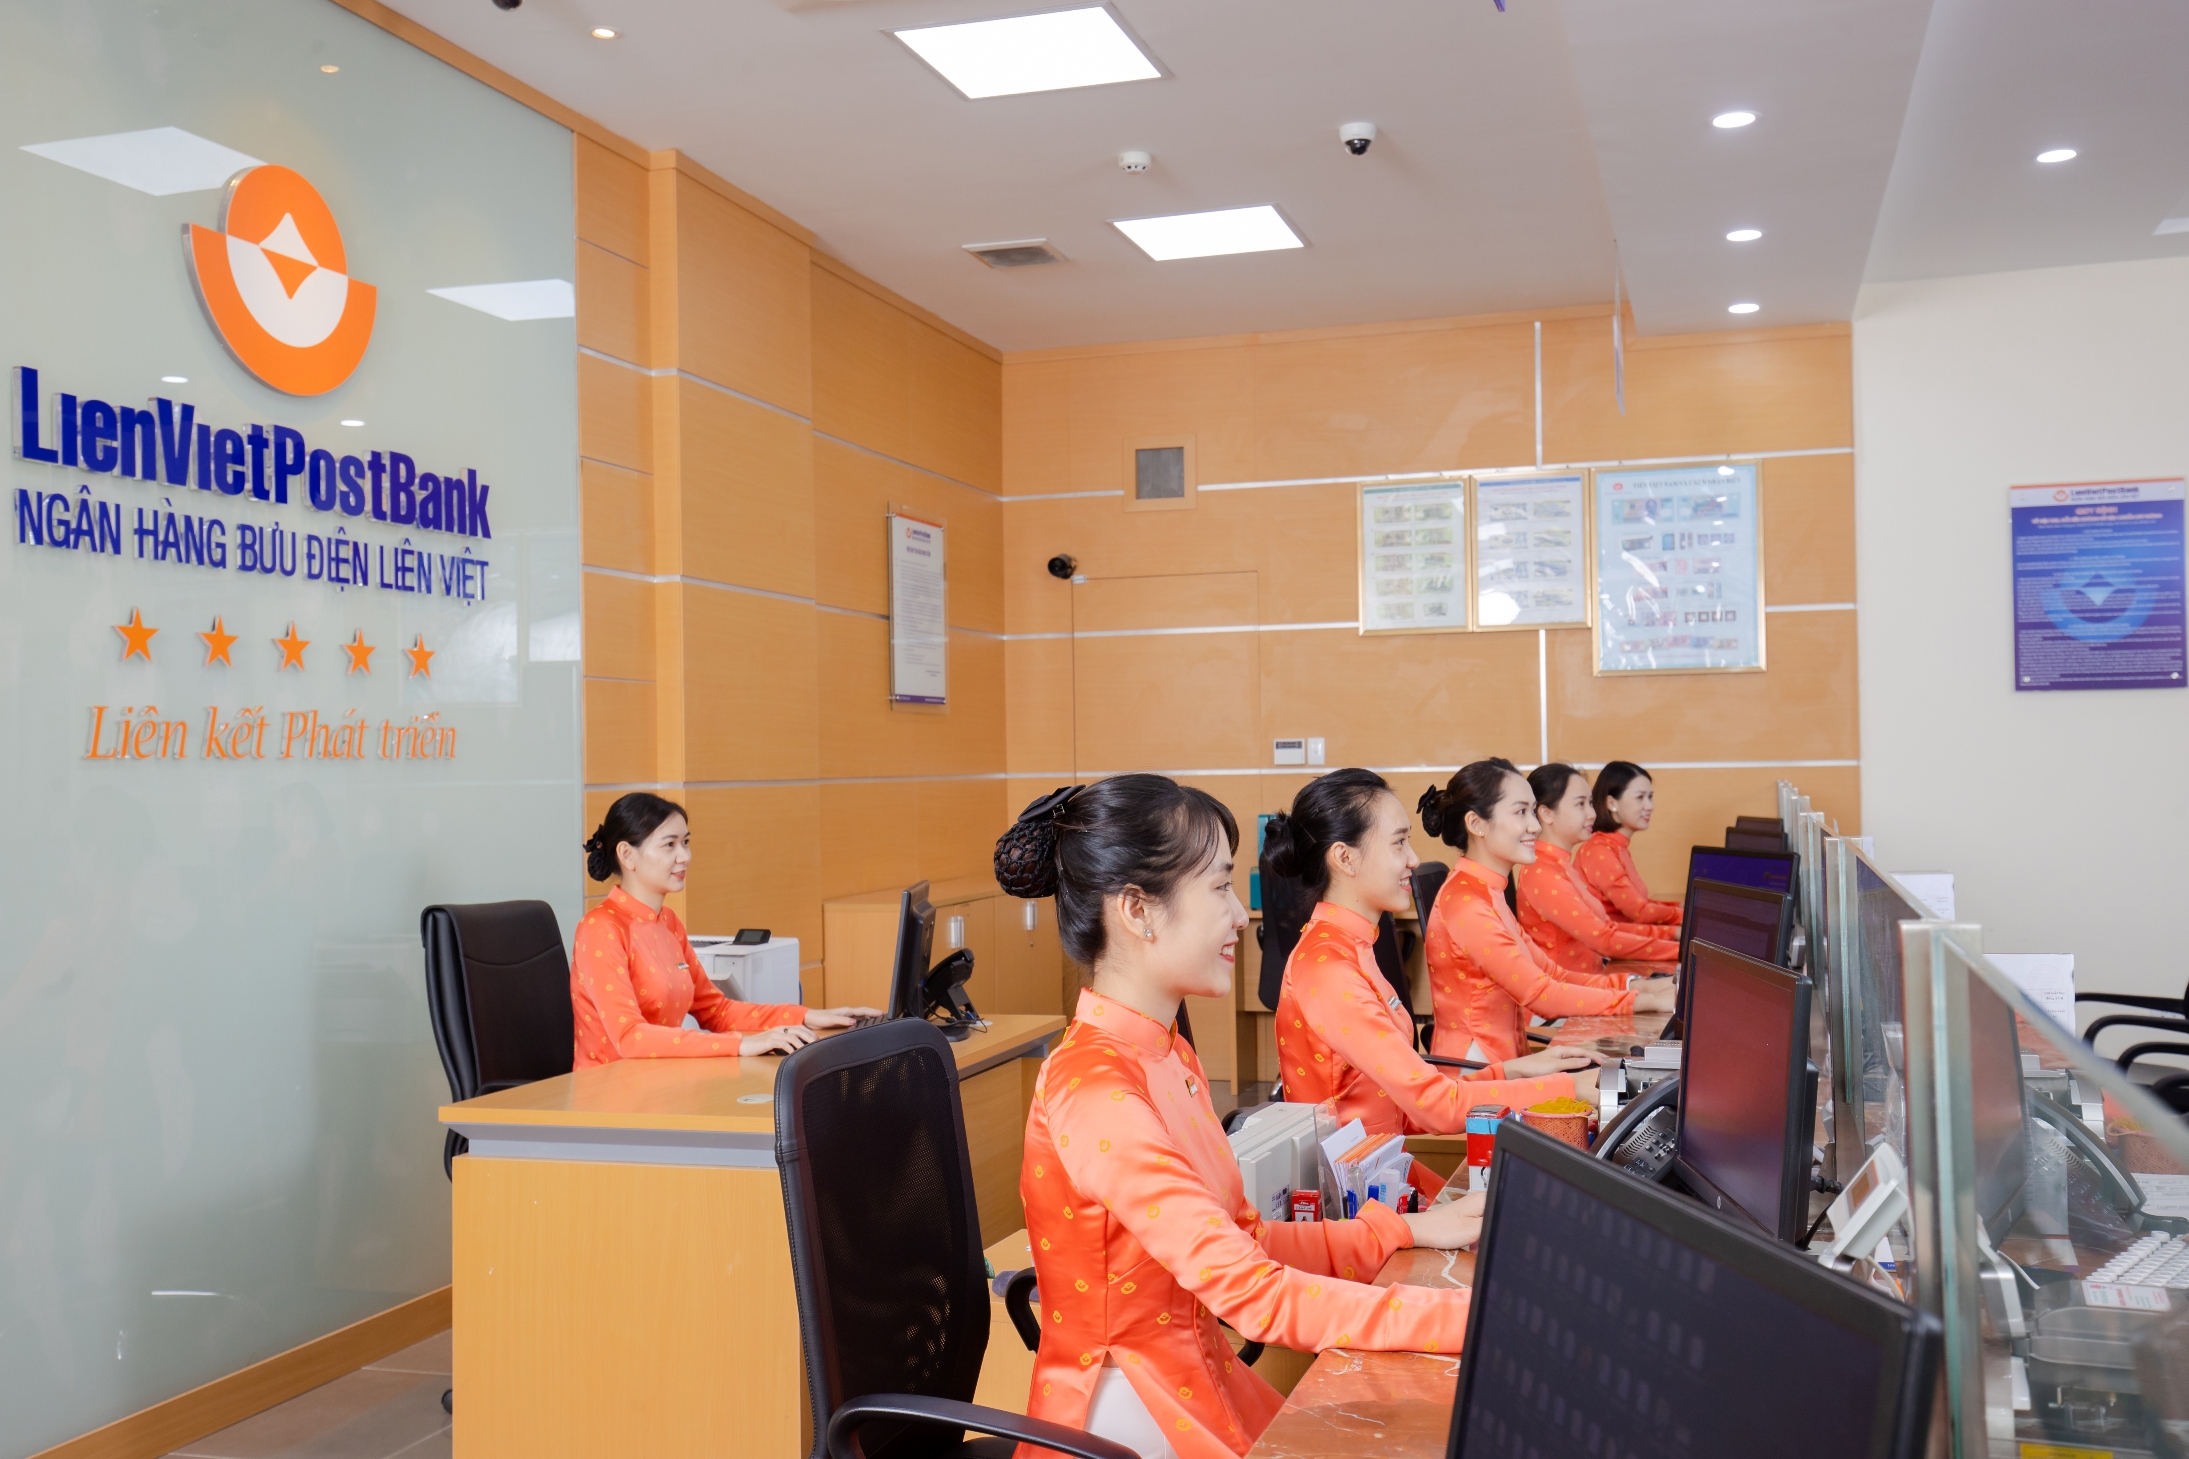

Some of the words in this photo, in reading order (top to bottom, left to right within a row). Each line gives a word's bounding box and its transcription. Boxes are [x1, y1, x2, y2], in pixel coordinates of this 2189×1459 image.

[15, 484, 121, 555] NGÂN
[134, 497, 227, 569] HÀNG
[237, 522, 296, 577] BƯU
[304, 526, 369, 592] ĐIỆN
[376, 537, 432, 595] LIÊN
[437, 546, 489, 606] VIỆT
[84, 705, 188, 759] Liên
[202, 705, 270, 759] kết
[280, 708, 369, 759] Phát
[378, 711, 457, 759] triển
